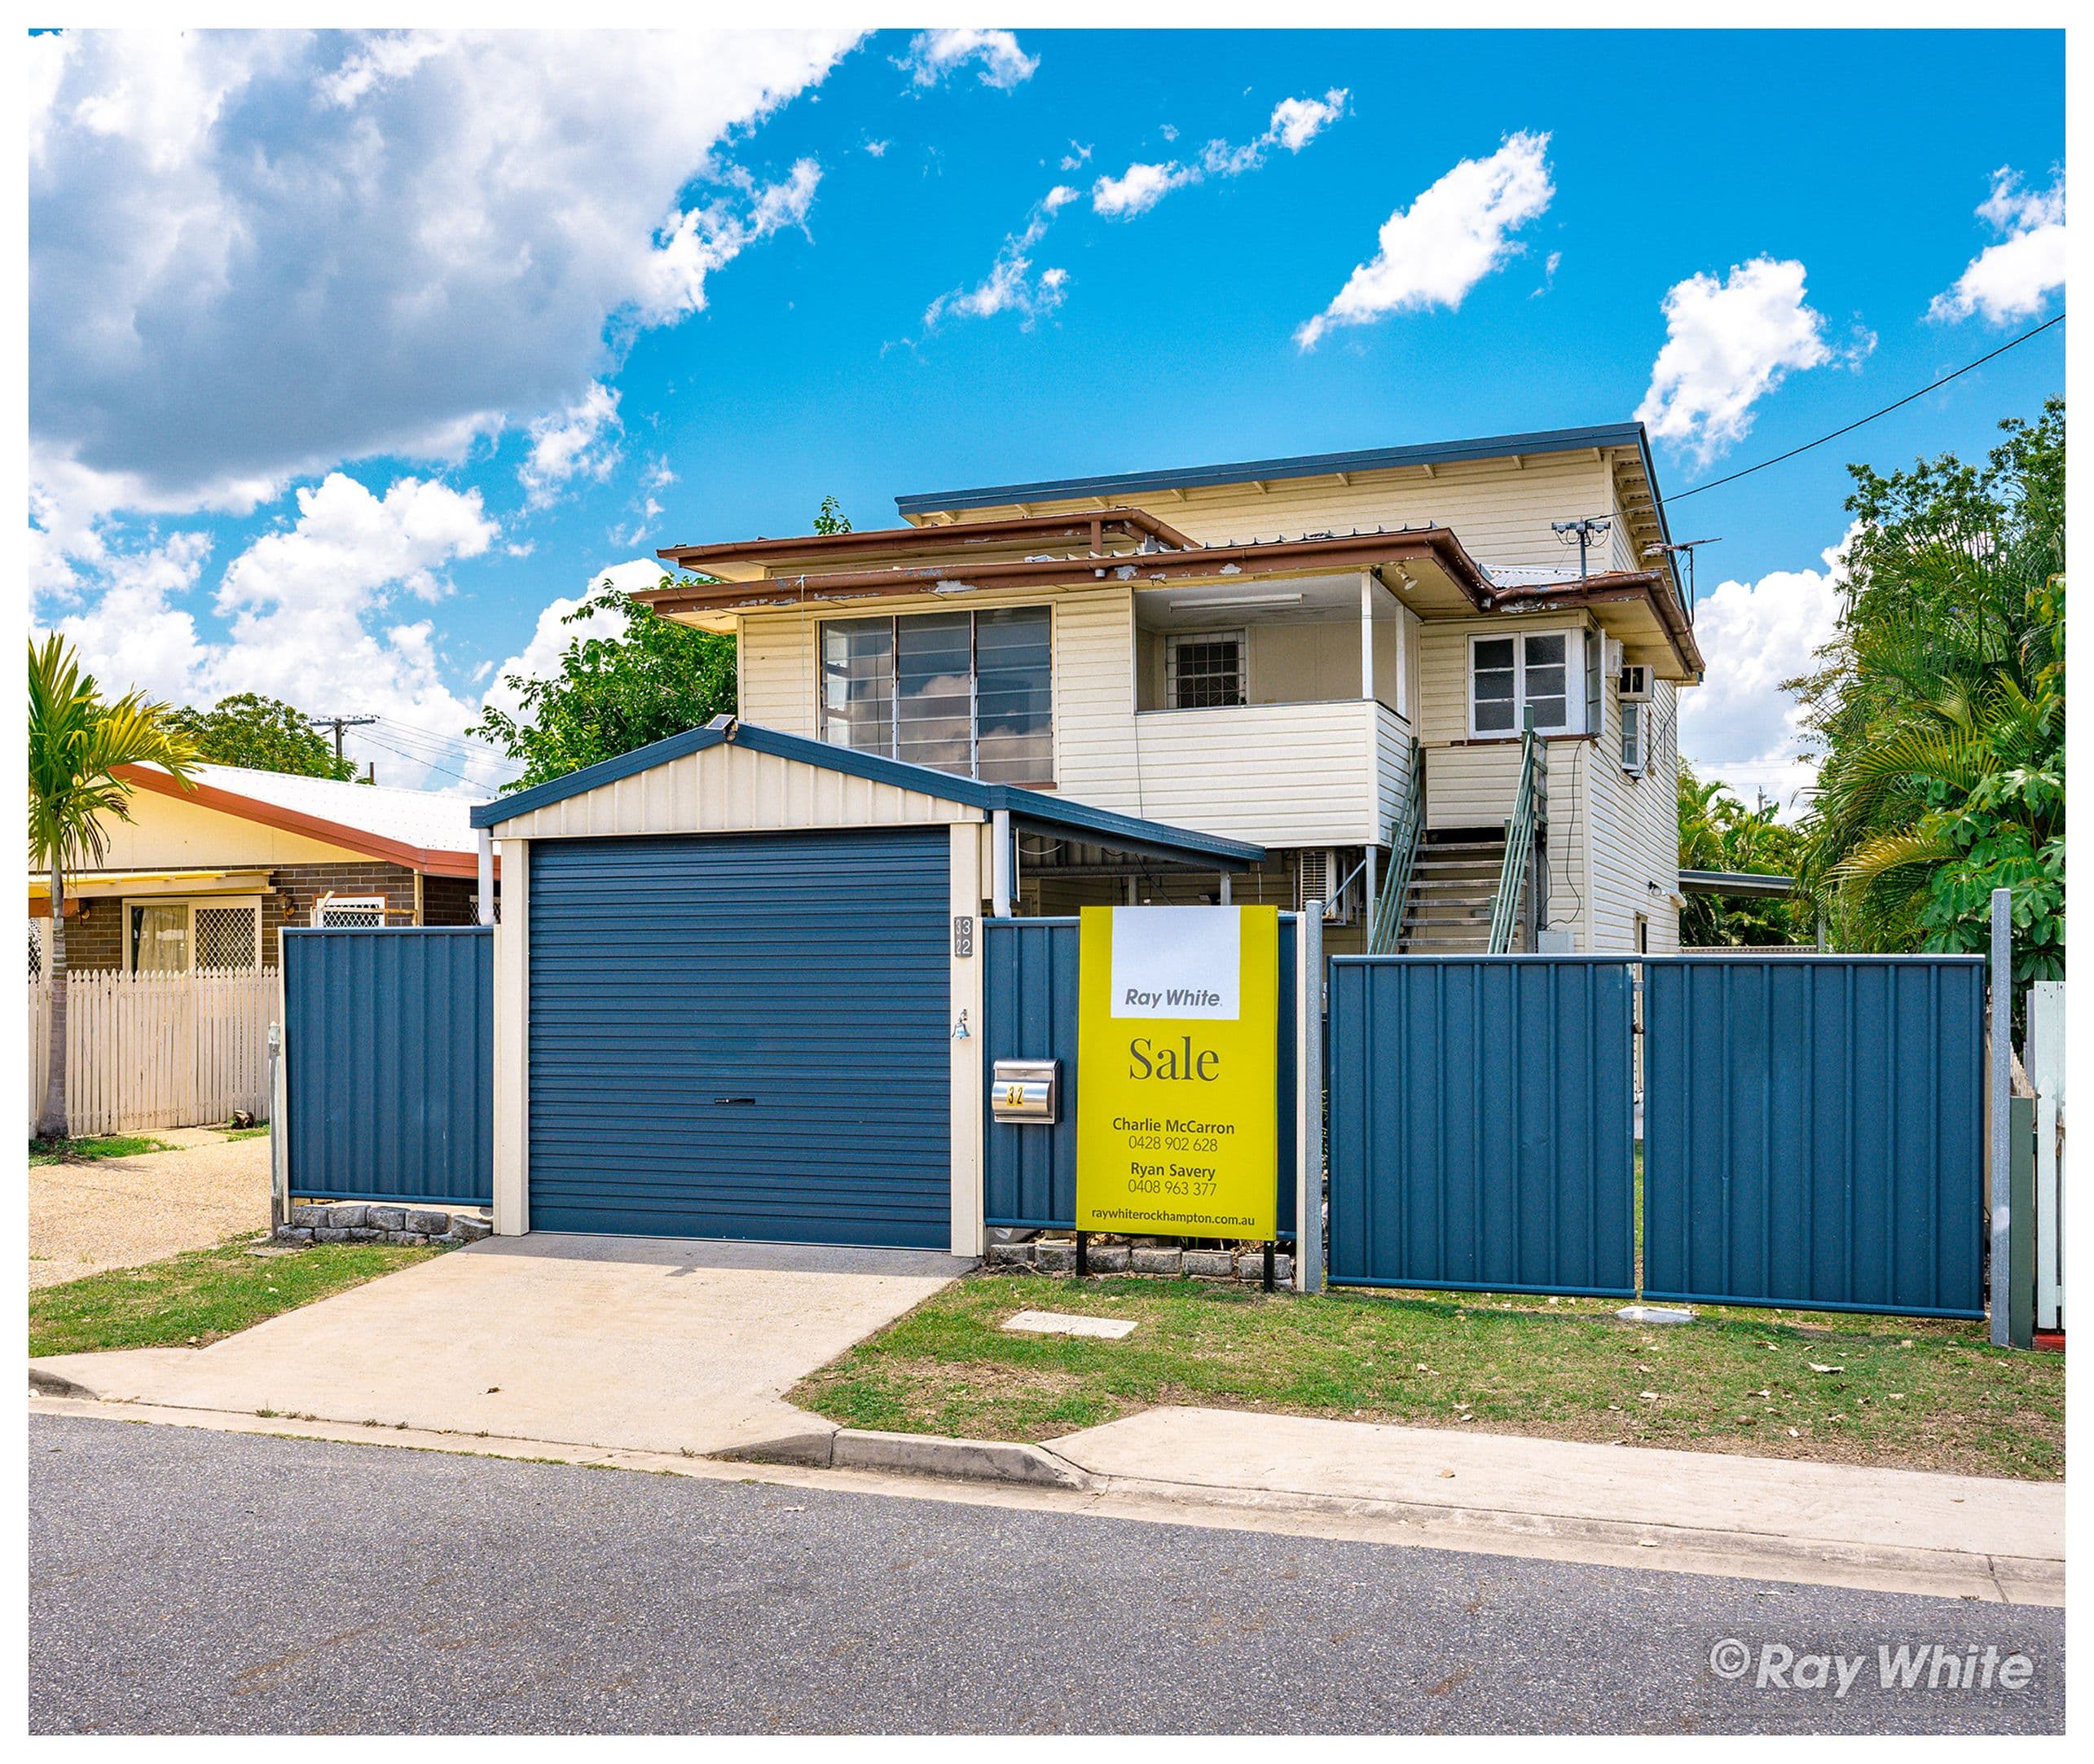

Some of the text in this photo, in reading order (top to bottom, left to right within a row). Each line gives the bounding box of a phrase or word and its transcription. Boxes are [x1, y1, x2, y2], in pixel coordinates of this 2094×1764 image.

[1125, 988, 1163, 1009] Ray
[1129, 1036, 1221, 1082] Sale
[1008, 1086, 1022, 1105] 32
[1112, 1117, 1235, 1135] Charlie McCarron
[1128, 1136, 1217, 1152] 0428 902 628
[1131, 1162, 1216, 1181] Ryan Savery
[1128, 1179, 1217, 1196] 0408 963 377
[1092, 1208, 1256, 1226] raywhiterockhampton.com.au
